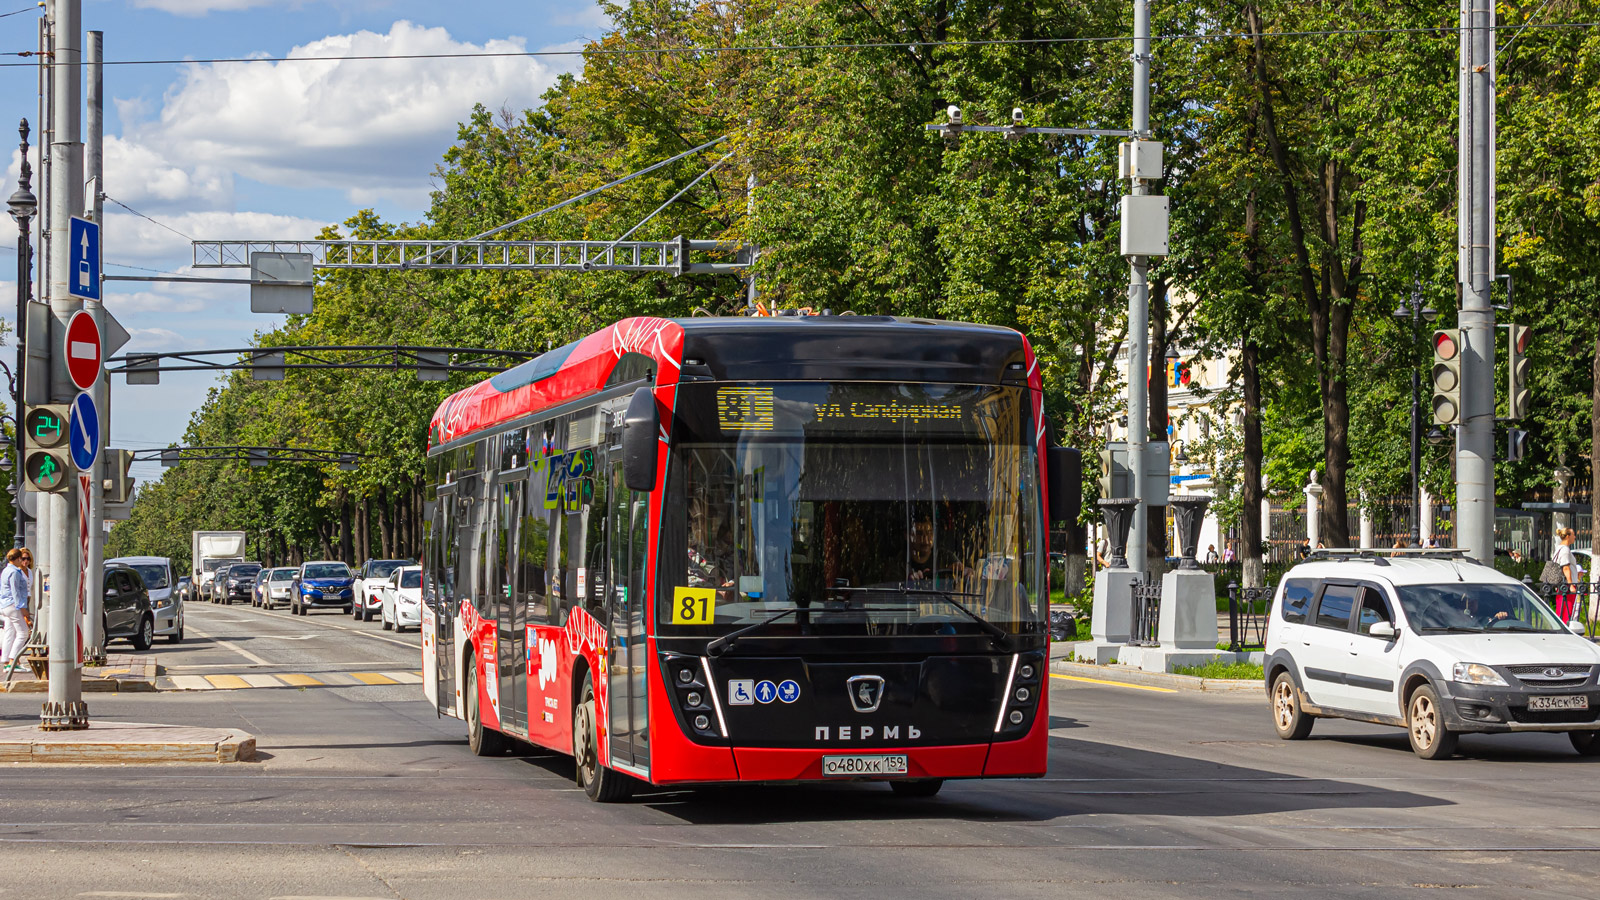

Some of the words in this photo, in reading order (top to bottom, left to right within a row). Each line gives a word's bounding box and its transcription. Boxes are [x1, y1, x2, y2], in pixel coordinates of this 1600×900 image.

[850, 399, 961, 423] Сапфирная
[36, 415, 60, 437] 24
[680, 596, 708, 621] 81
[1570, 696, 1585, 706] 159
[815, 725, 921, 740] ПЕРМЬ
[883, 757, 903, 768] 159
